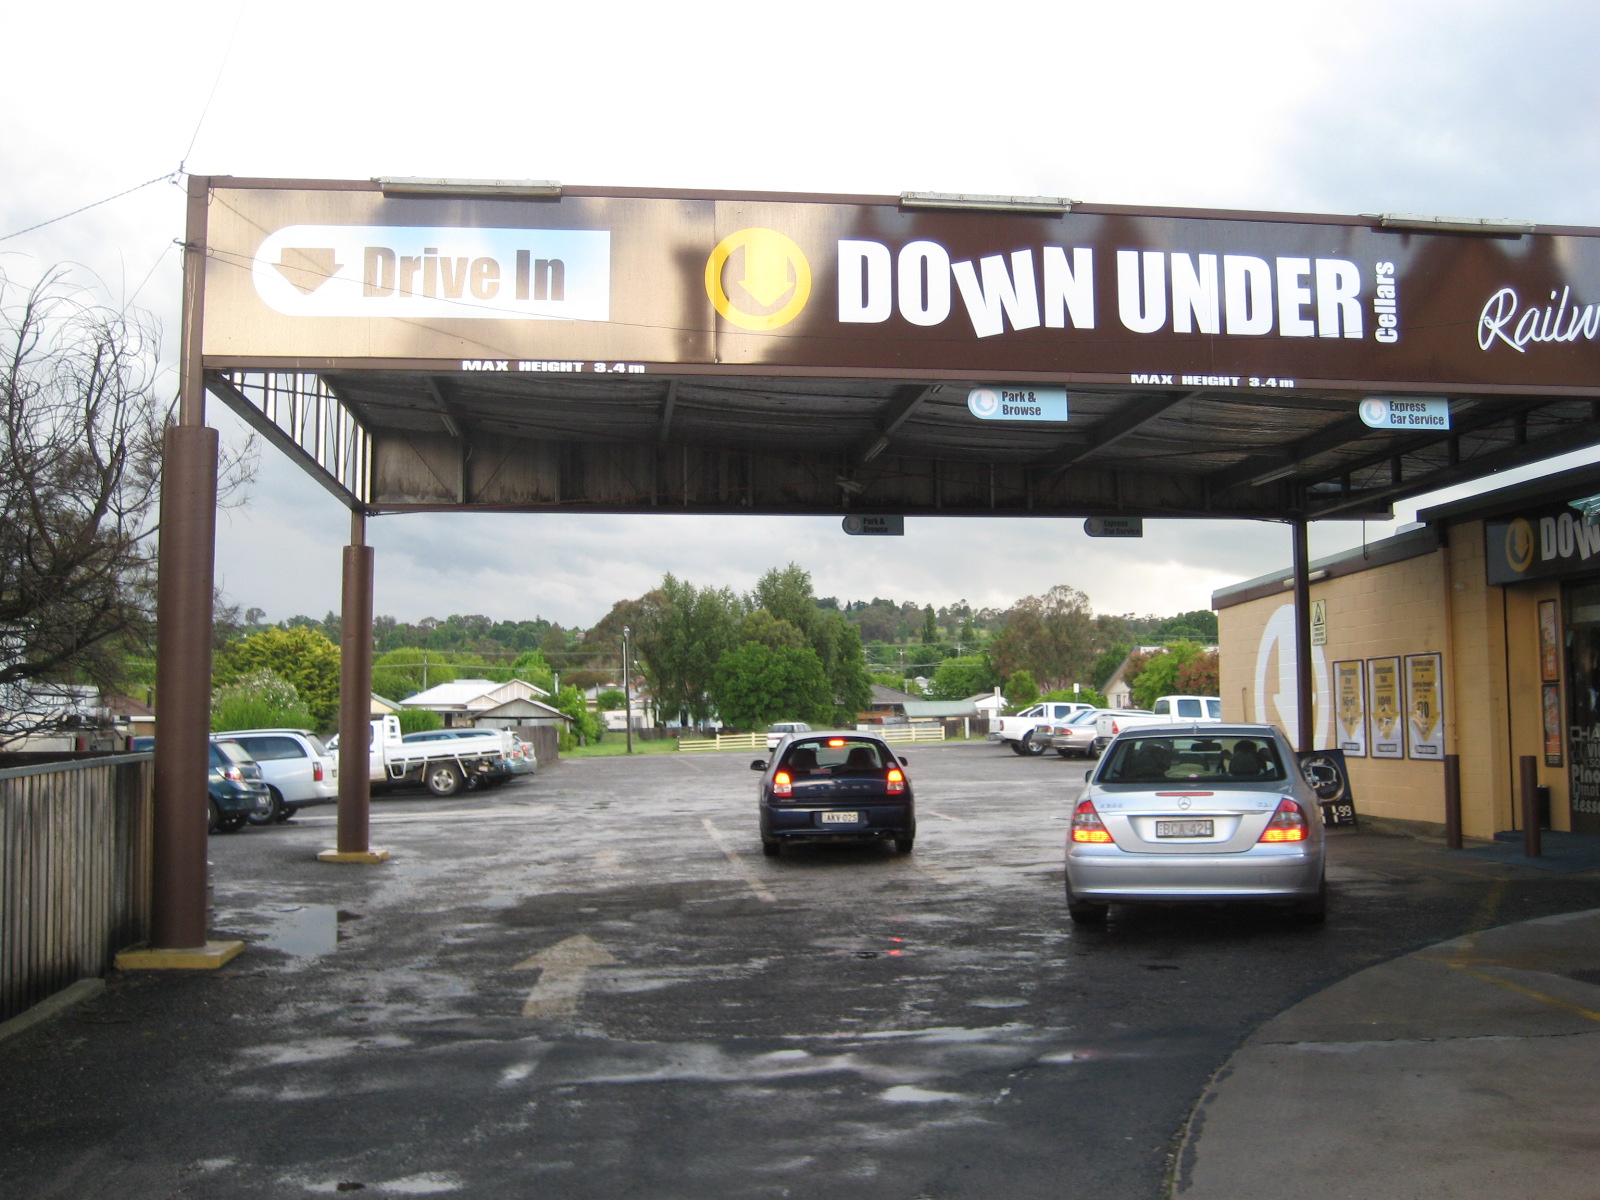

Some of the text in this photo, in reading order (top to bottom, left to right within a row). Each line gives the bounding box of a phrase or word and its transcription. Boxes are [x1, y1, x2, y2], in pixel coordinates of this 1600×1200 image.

[363, 246, 565, 301] Drive In
[838, 240, 1364, 339] DOWN UNDER
[1374, 261, 1398, 343] Cellars
[462, 360, 509, 371] MAX
[518, 361, 585, 373] HEIGHT
[1130, 374, 1173, 385] MAX
[1181, 375, 1240, 387] HEIGHT
[1001, 391, 1036, 403] Park &
[1002, 404, 1042, 416] Browse
[1389, 400, 1426, 412] Express
[1390, 413, 1445, 426] Car Service
